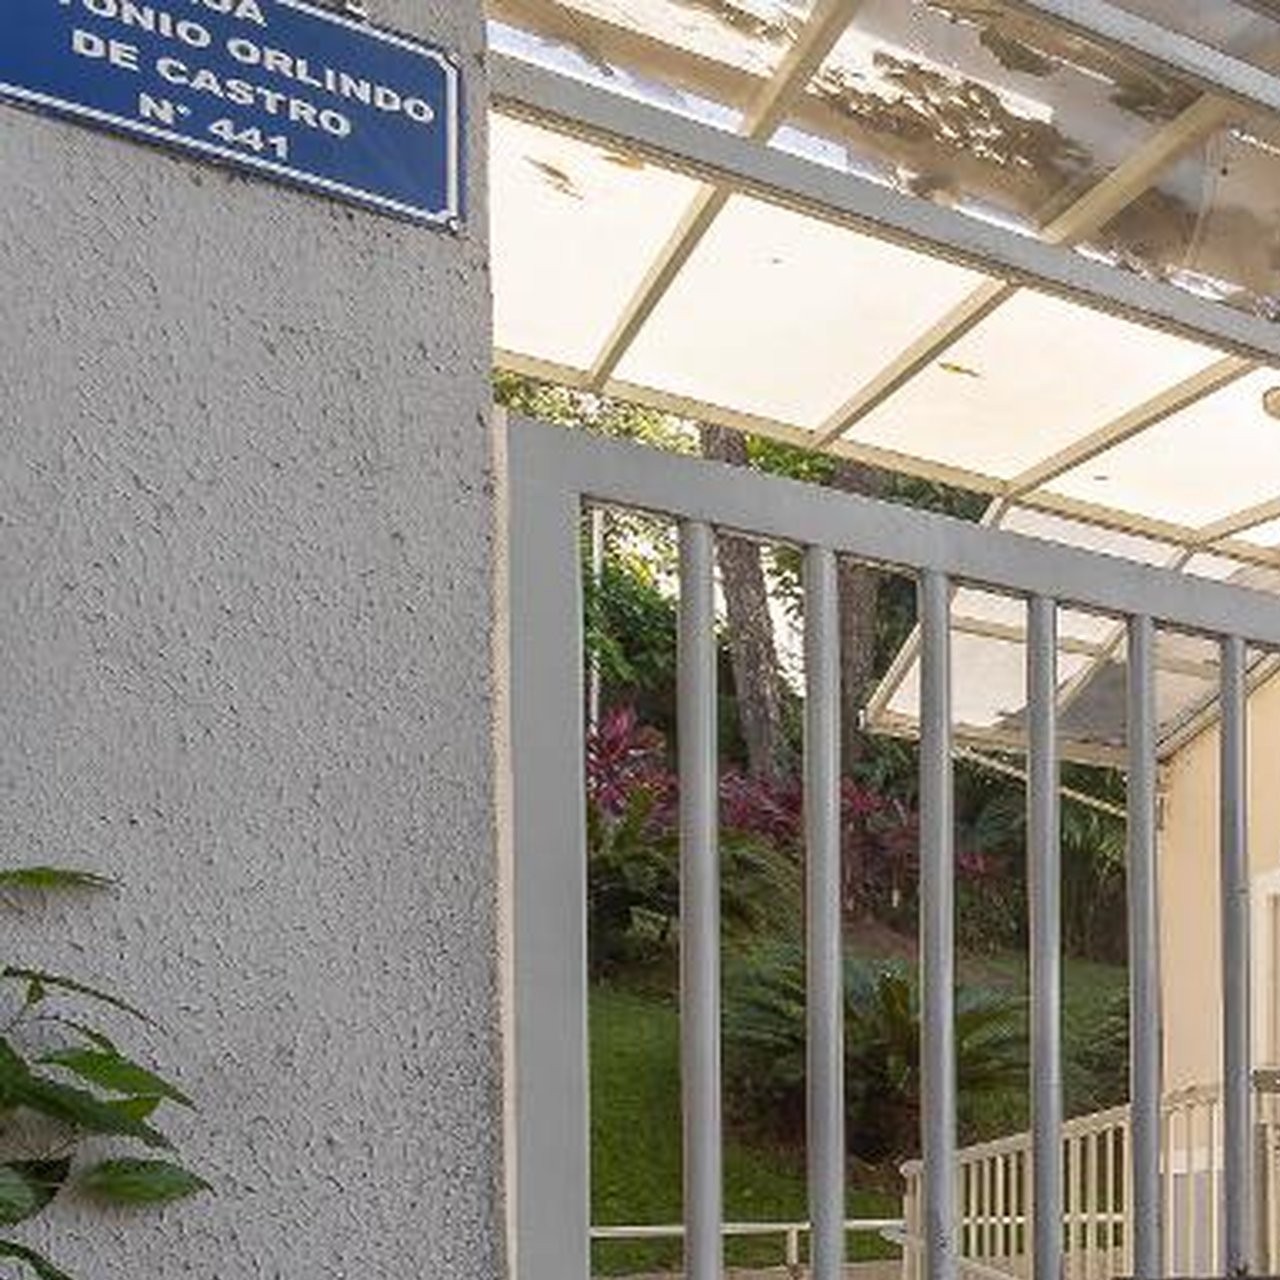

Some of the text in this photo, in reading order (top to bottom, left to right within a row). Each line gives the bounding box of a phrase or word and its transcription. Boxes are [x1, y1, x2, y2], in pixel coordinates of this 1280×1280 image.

[58, 0, 211, 47] ONIO
[227, 38, 435, 123] ORLINDO
[71, 29, 351, 137] DE CASTRO
[208, 118, 288, 159] 441
